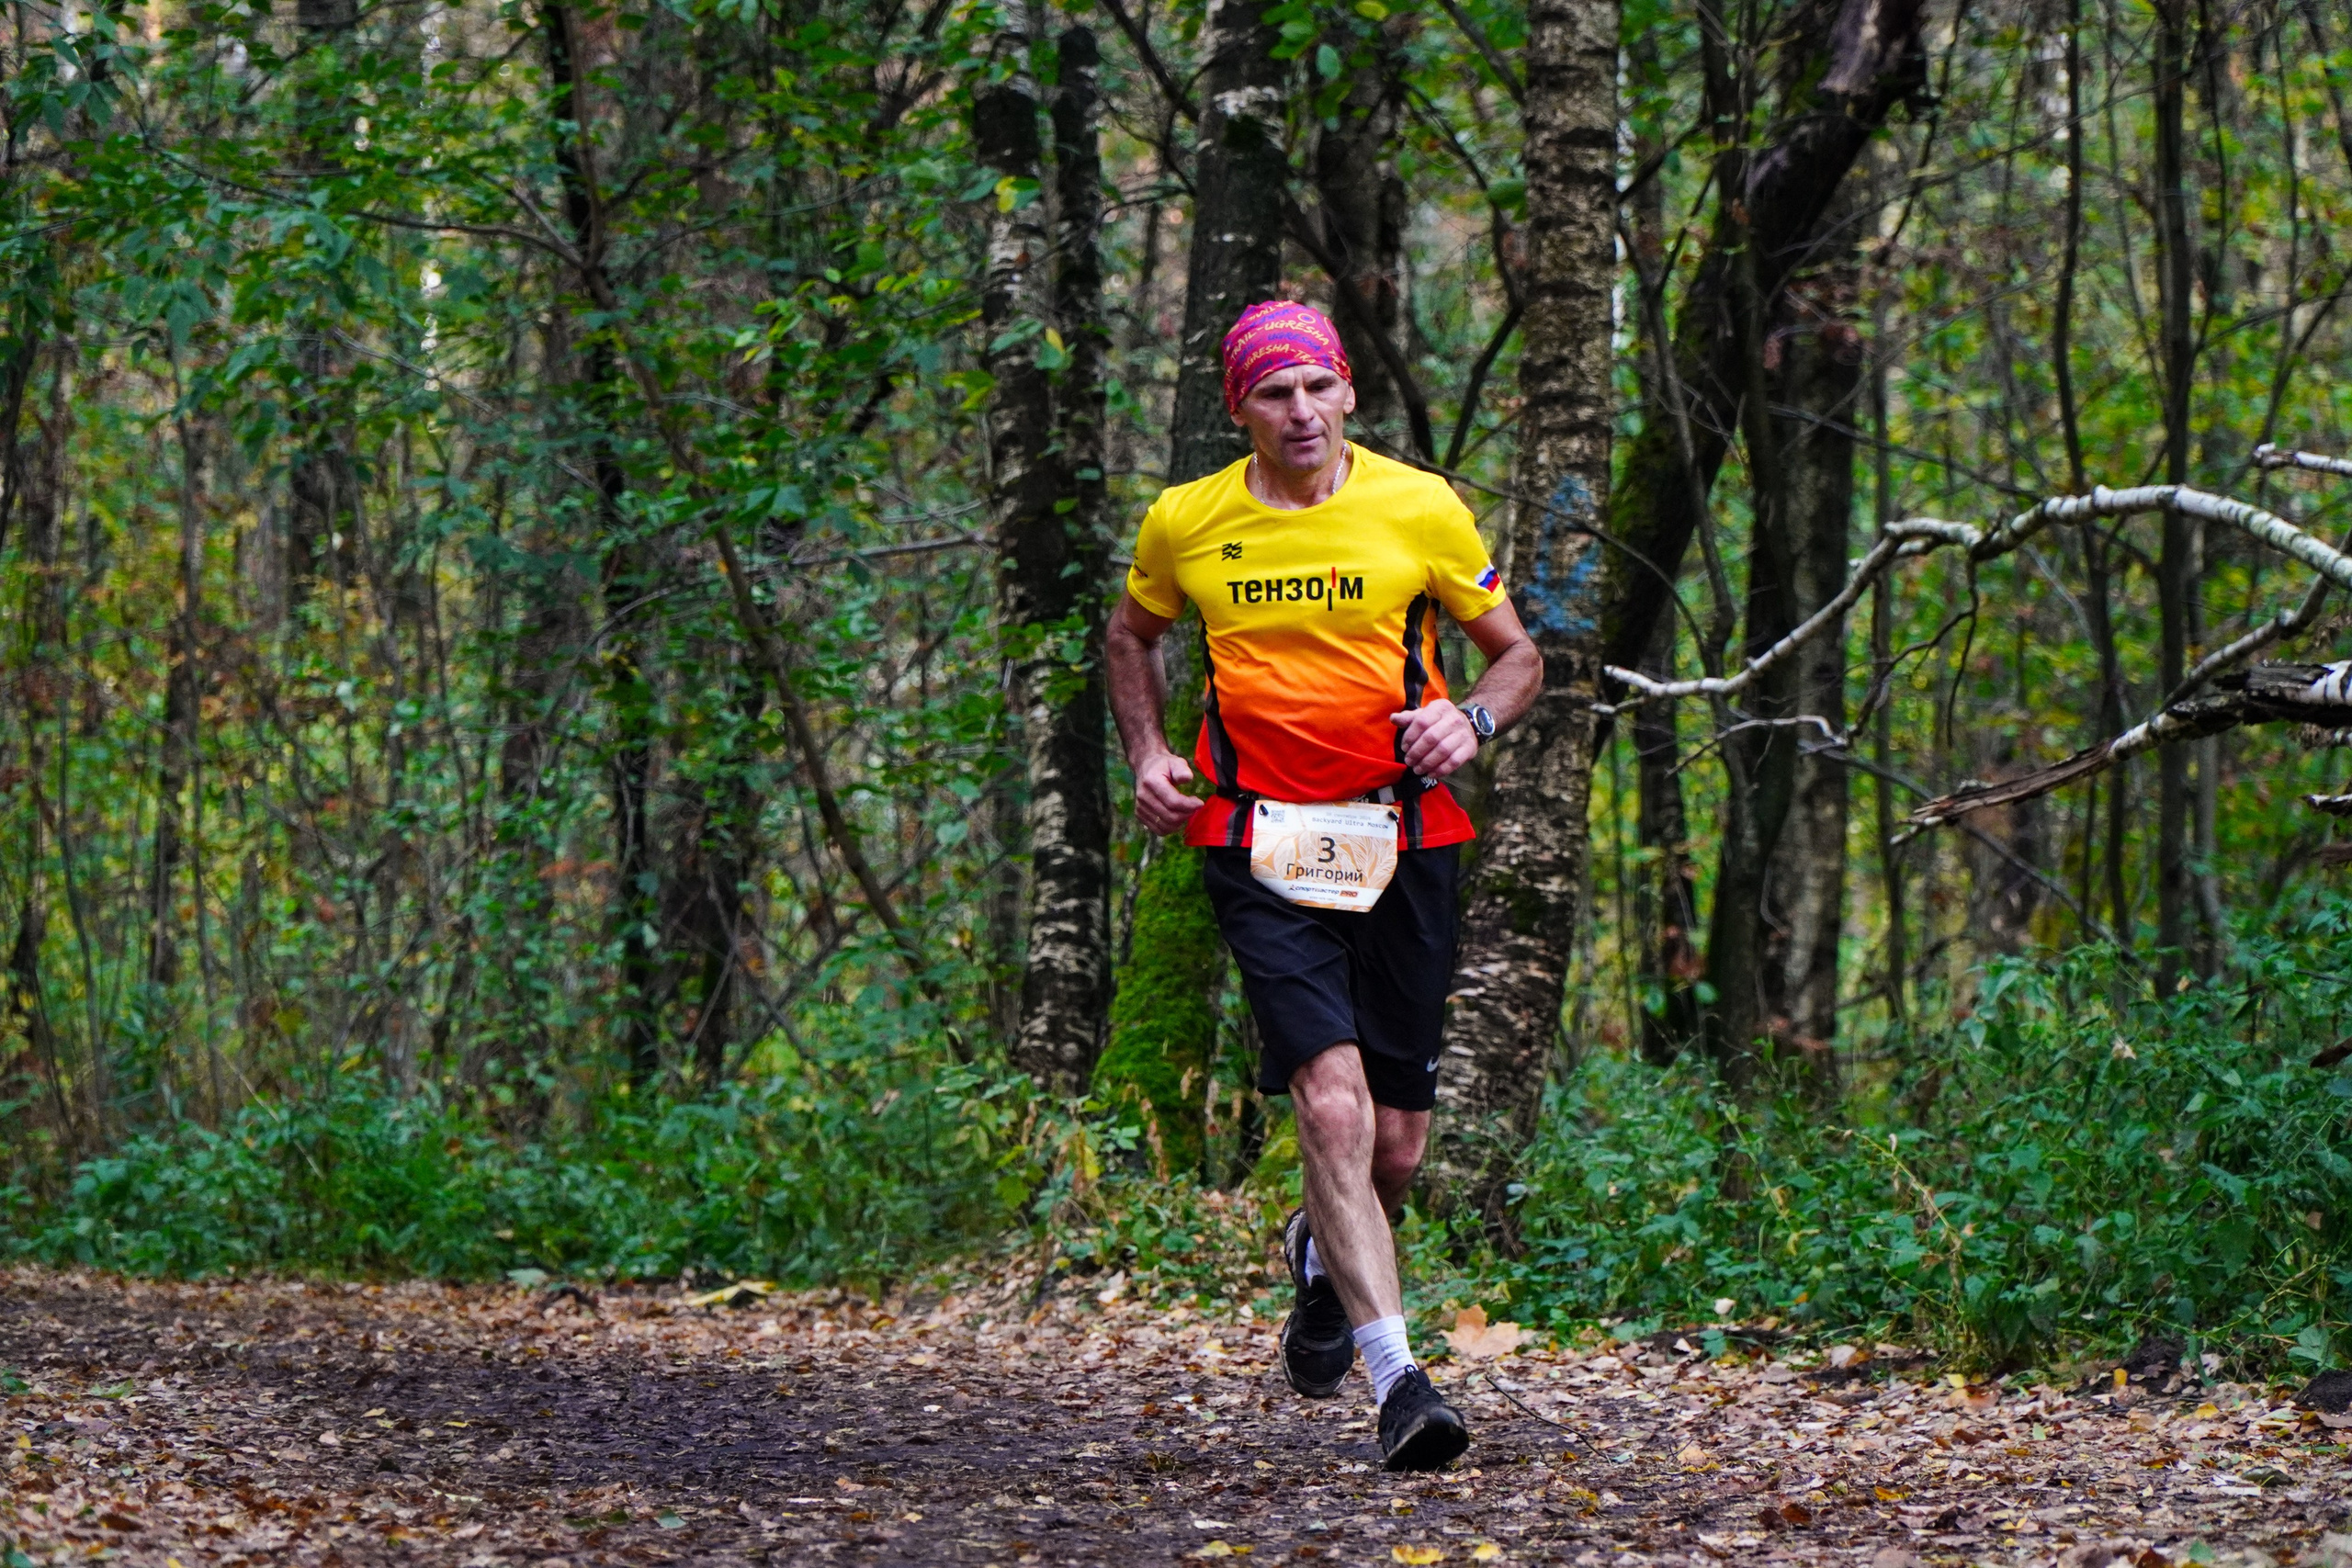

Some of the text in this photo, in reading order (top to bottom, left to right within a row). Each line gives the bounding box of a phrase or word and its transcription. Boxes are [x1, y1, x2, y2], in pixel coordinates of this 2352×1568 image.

[1312, 817, 1342, 825] Backyard
[1317, 837, 1336, 863] 3
[1286, 863, 1363, 883] Григорий
